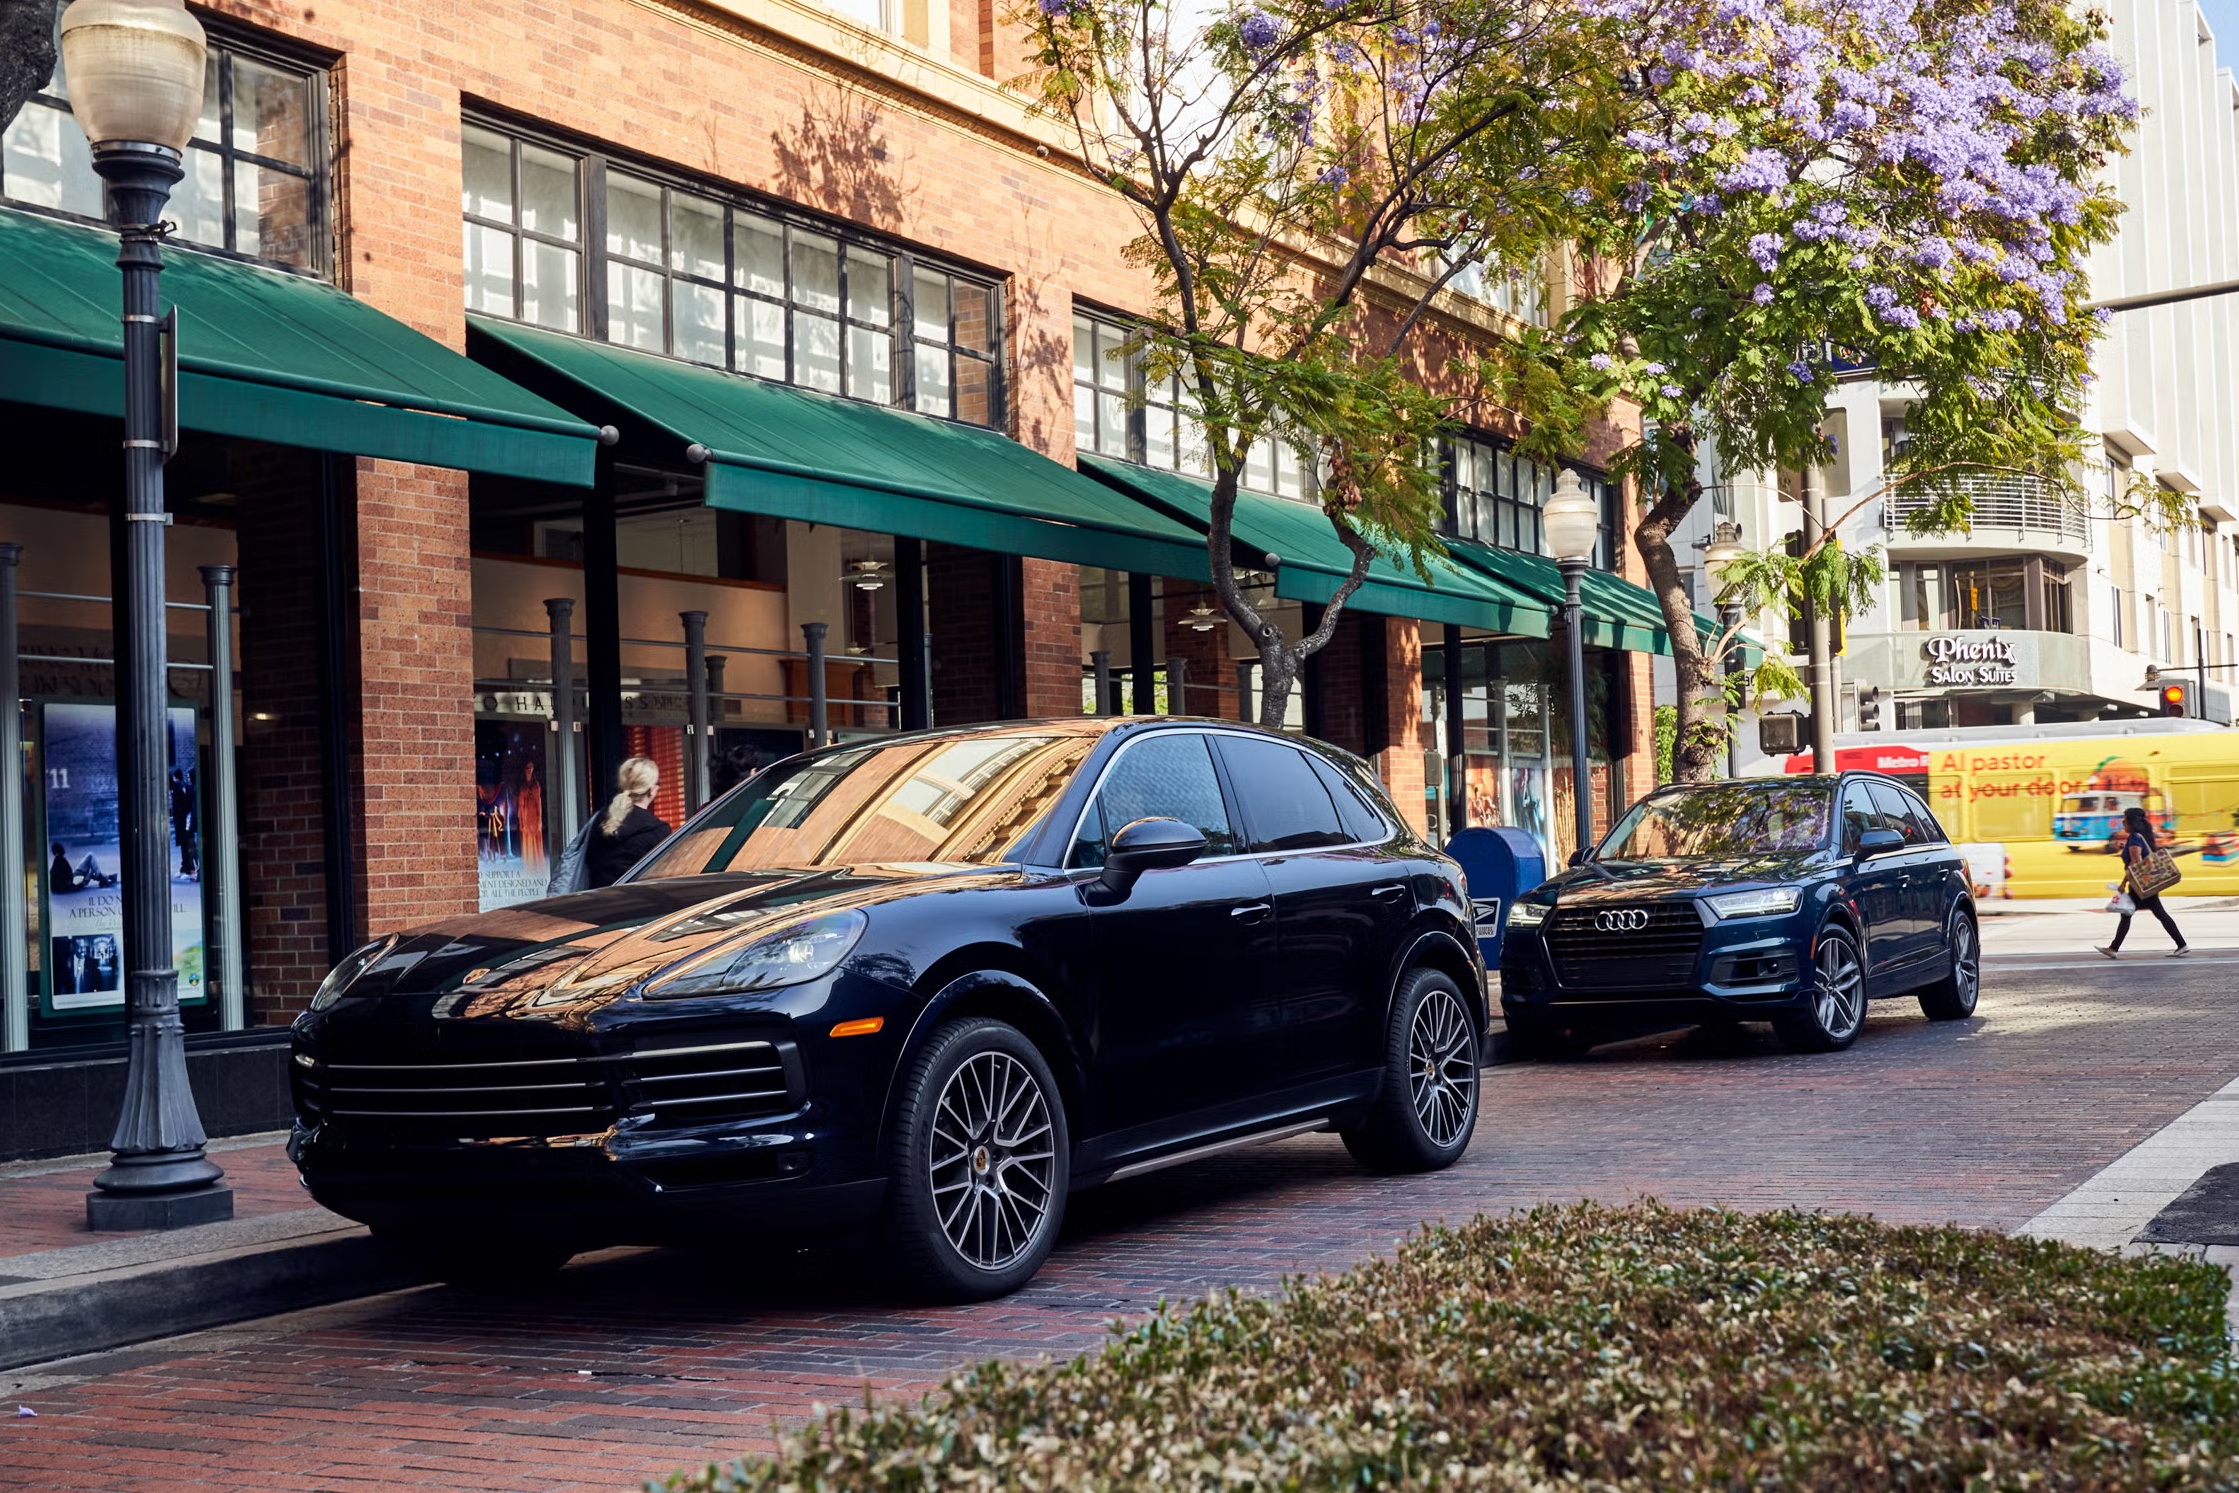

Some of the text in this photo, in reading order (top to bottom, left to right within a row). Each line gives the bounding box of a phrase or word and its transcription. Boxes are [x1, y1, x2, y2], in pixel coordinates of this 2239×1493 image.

[1927, 636, 2018, 664] Phenix
[1877, 756, 1919, 768] Metro
[1971, 753, 2046, 776] pastor
[1941, 779, 1964, 798] at
[1969, 780, 2022, 803] your
[499, 879, 531, 888] DESIGNED
[532, 878, 548, 887] AND
[69, 908, 77, 918] A
[78, 907, 116, 918] PERSON
